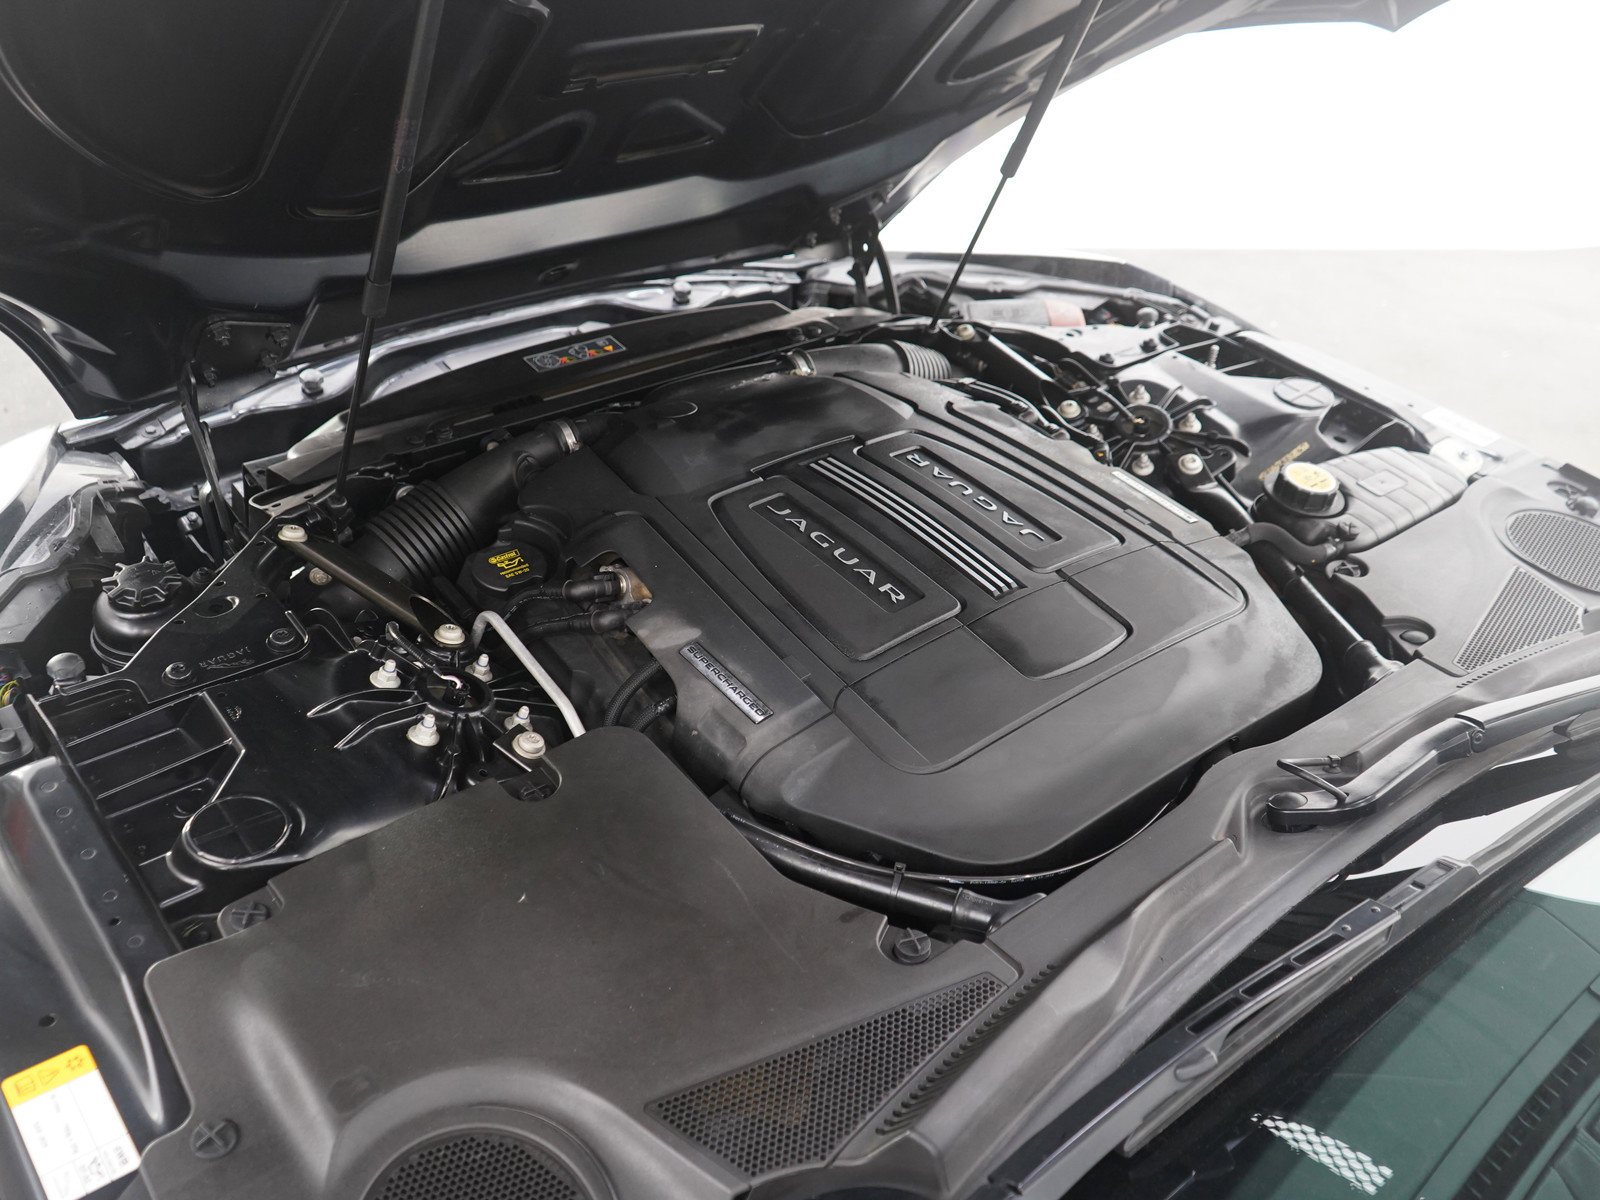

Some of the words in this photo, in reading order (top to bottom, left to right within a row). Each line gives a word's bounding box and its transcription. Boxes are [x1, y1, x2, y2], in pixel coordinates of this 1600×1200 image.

[906, 453, 1045, 541] JAGUAR
[767, 505, 905, 603] JAGUAR
[199, 645, 251, 669] JAGUAR
[687, 645, 767, 717] SUPERCHARGED
